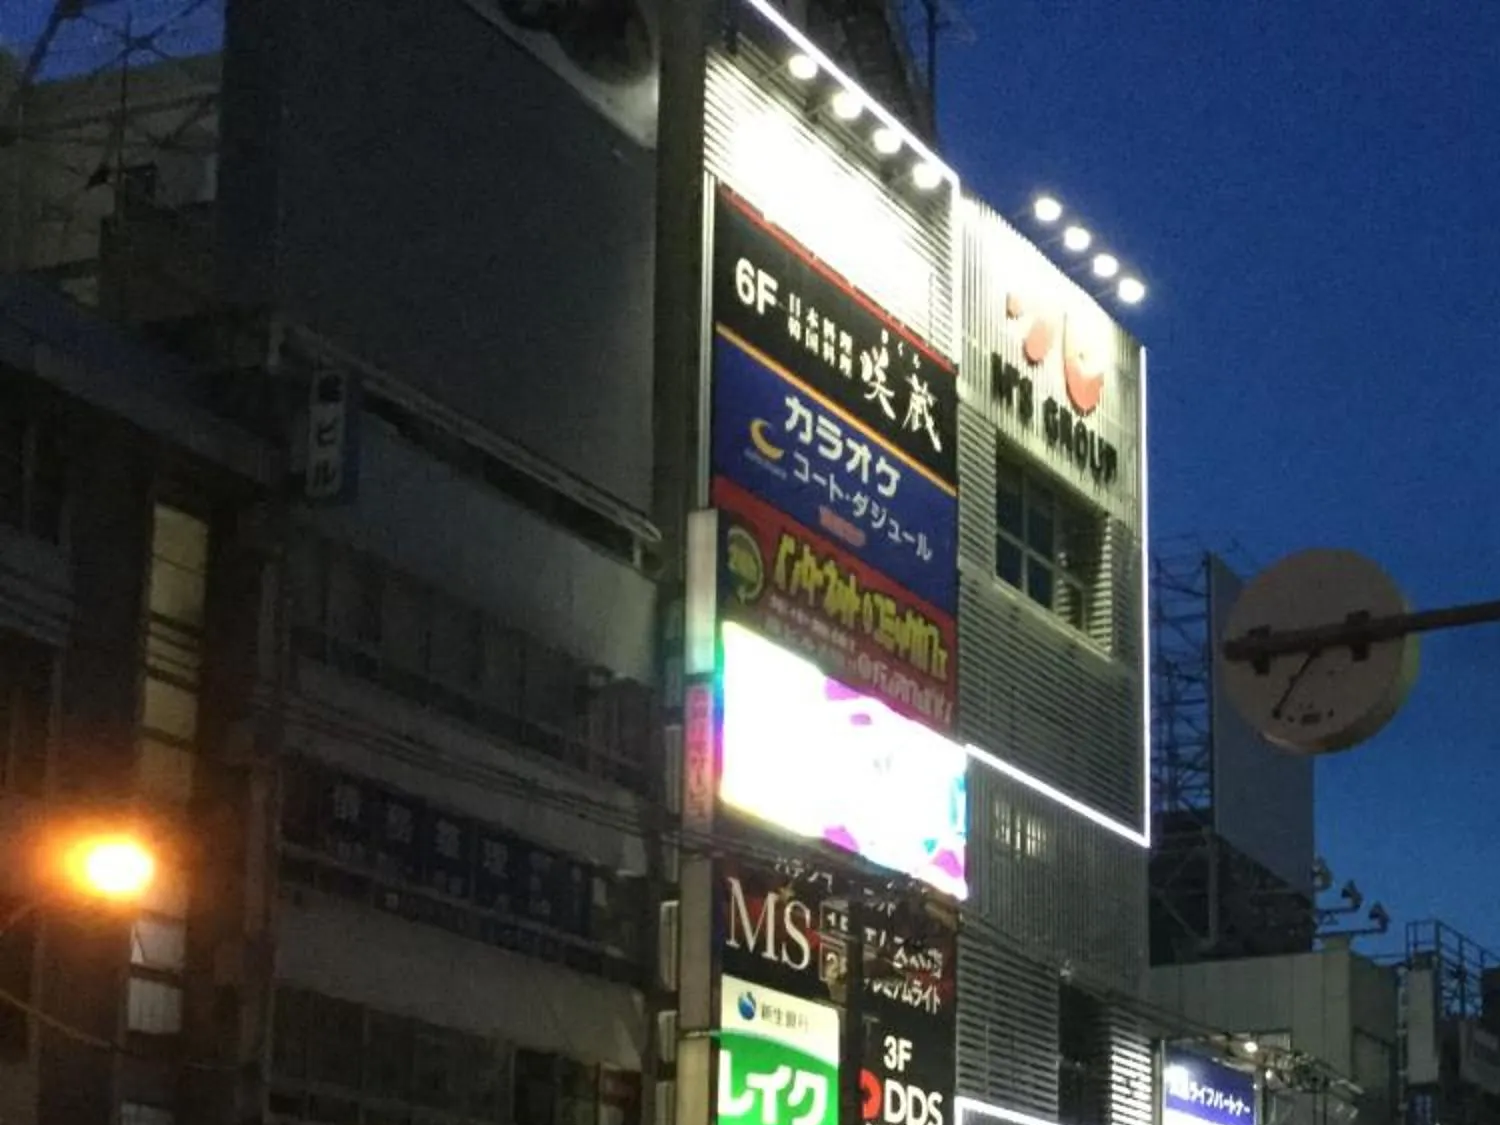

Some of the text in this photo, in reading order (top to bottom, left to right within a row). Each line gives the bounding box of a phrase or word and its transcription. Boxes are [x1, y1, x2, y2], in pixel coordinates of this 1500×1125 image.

[735, 257, 779, 314] 6F
[784, 395, 901, 498] カラオケ
[725, 877, 831, 974] MS
[883, 1034, 913, 1073] 3F
